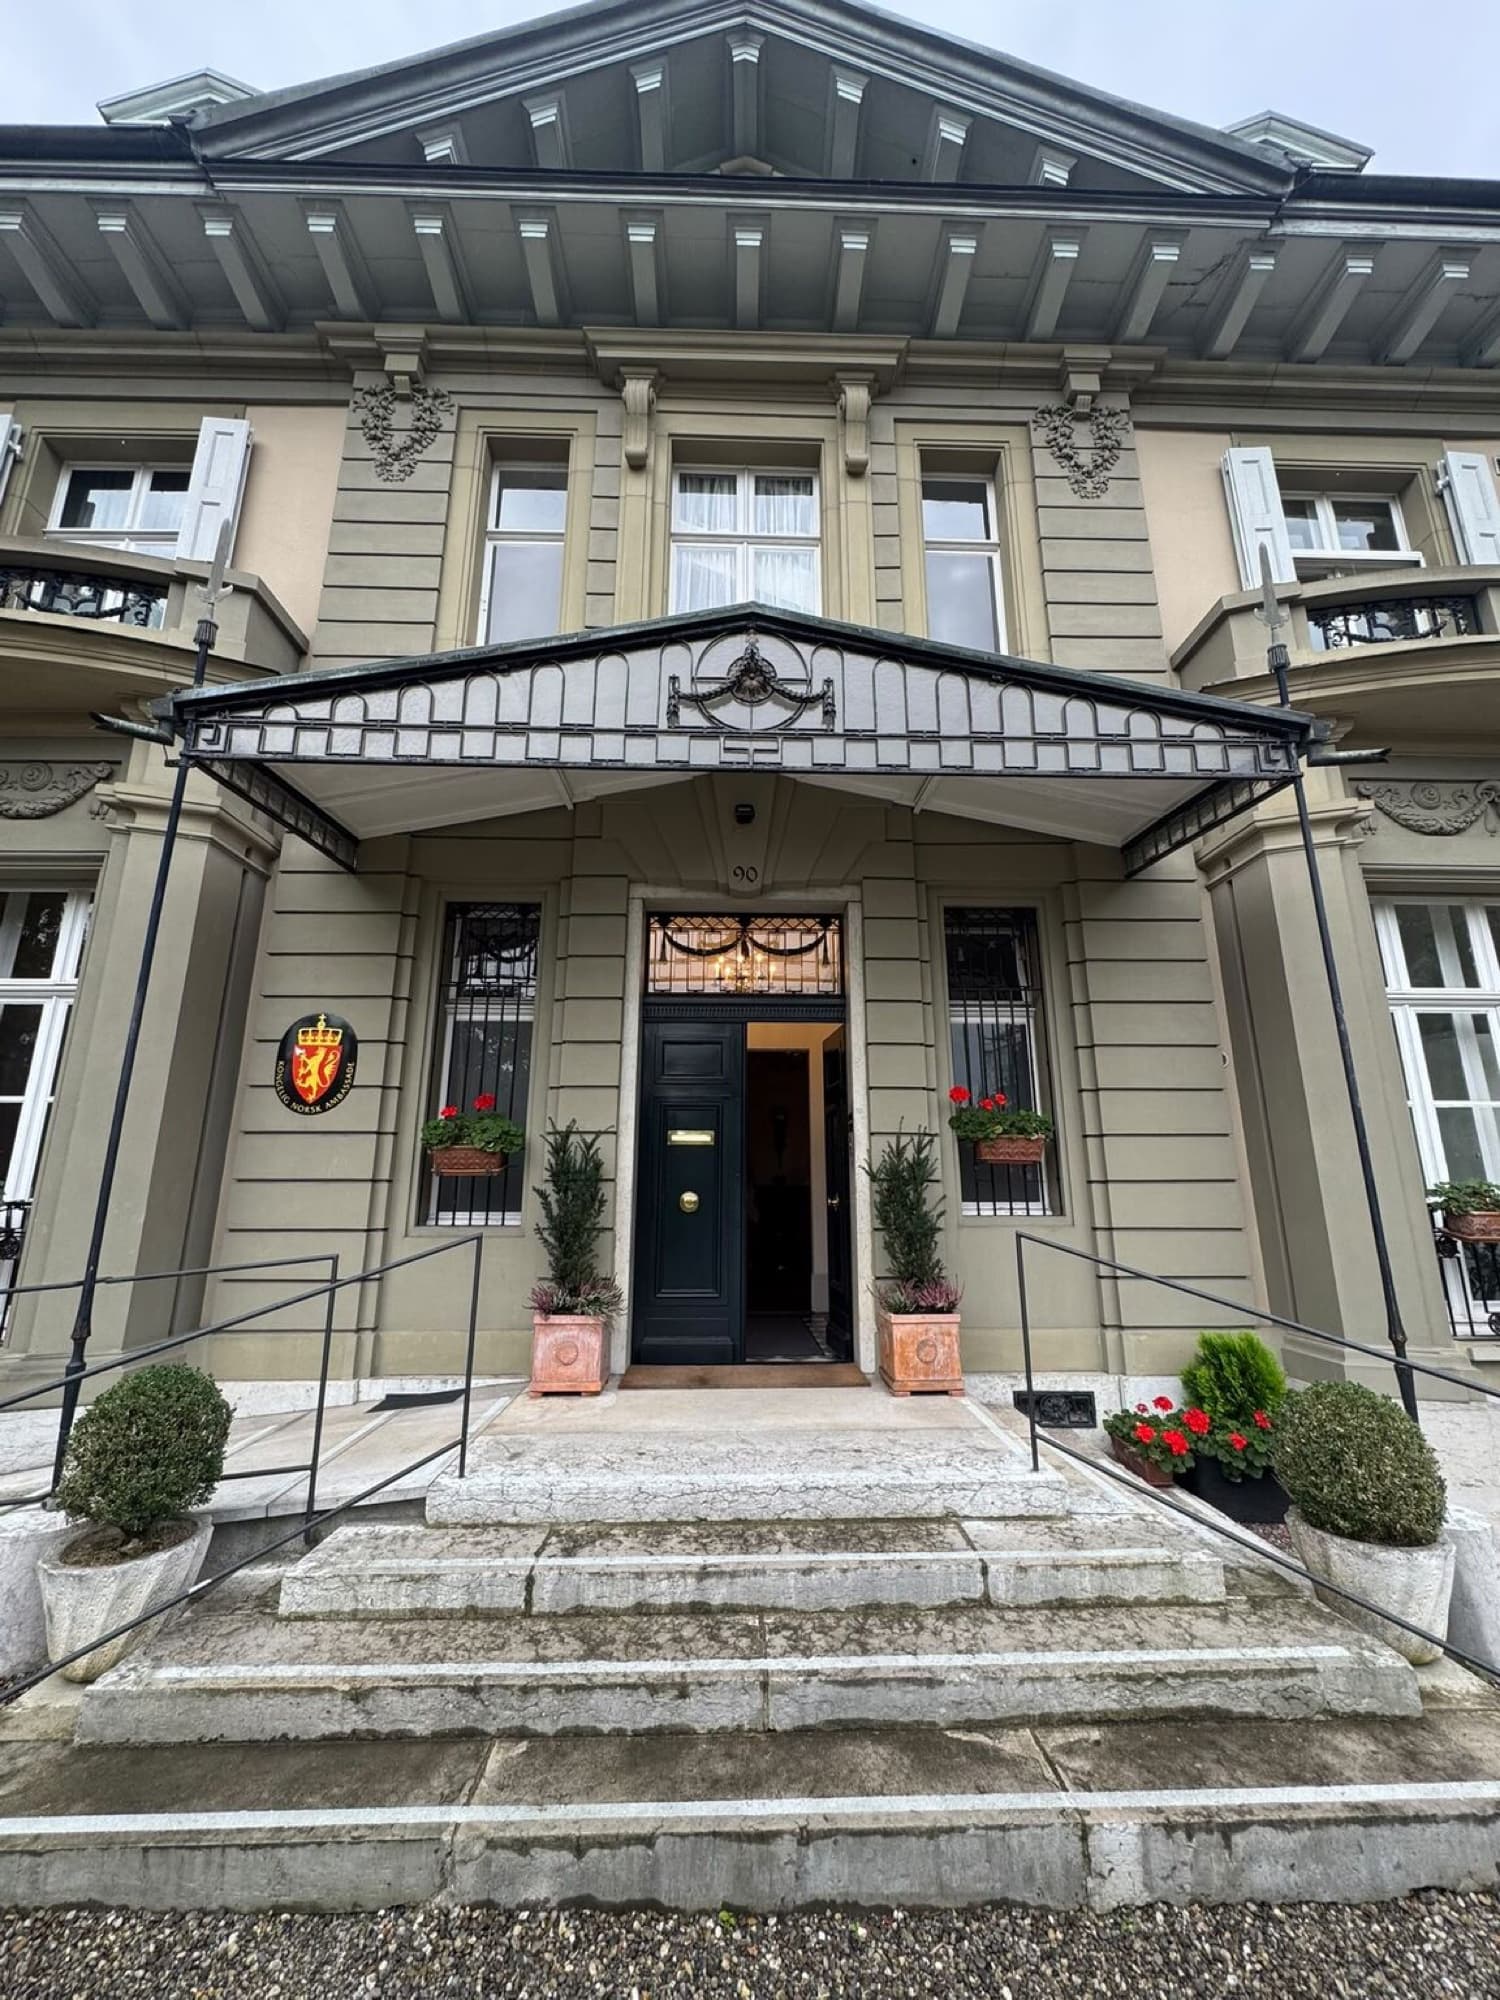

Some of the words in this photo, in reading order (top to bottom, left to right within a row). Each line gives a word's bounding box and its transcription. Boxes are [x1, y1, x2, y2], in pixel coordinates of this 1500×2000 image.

[733, 865, 758, 883] 90
[276, 1061, 291, 1104] KONGELIG
[290, 1102, 323, 1113] NORSK
[325, 1062, 355, 1109] AMBASSADE
